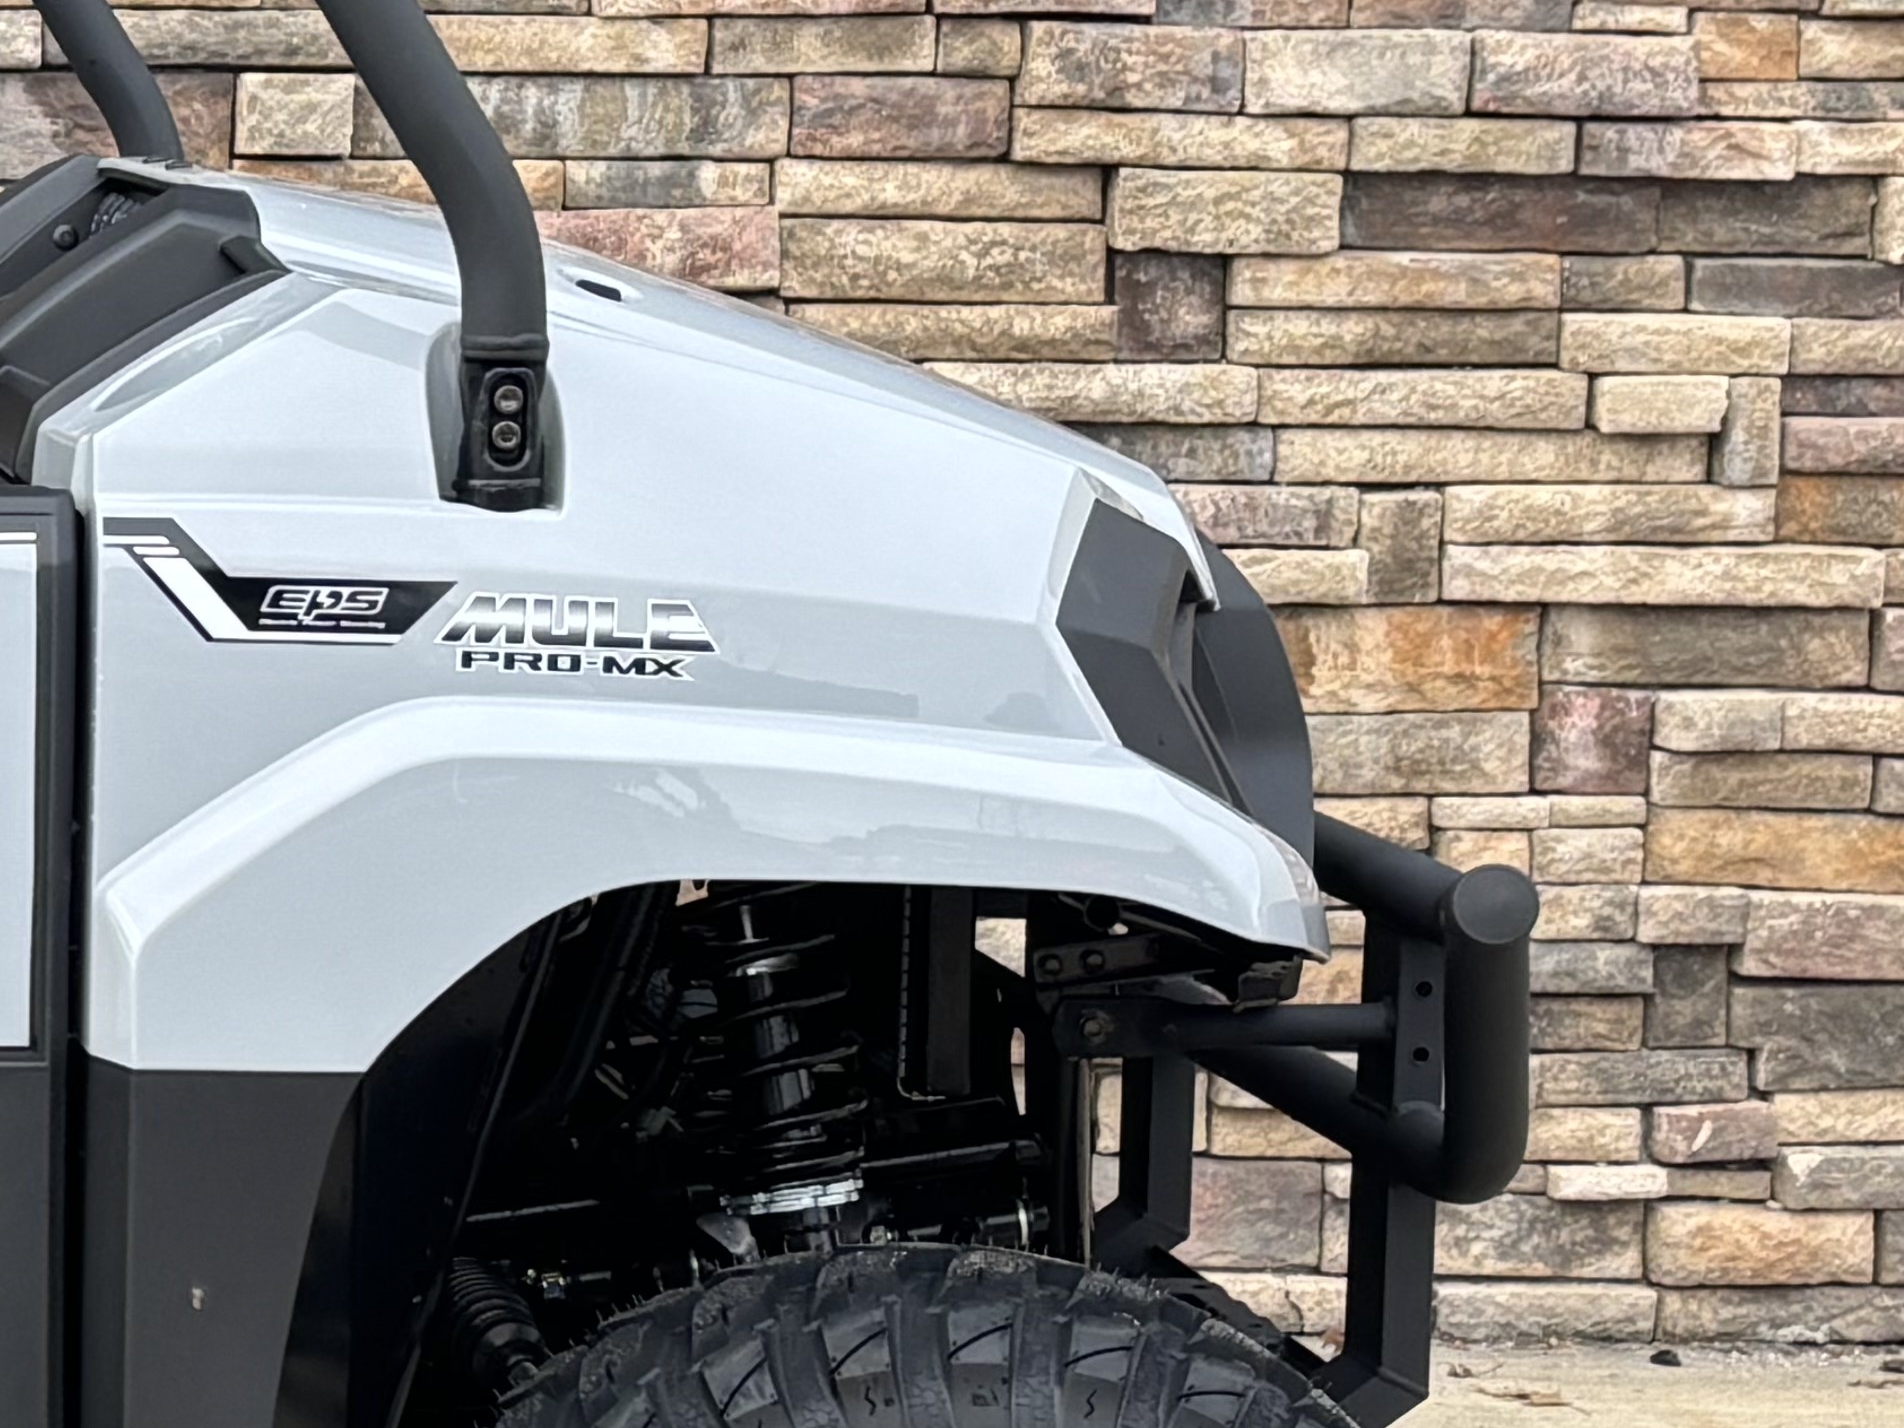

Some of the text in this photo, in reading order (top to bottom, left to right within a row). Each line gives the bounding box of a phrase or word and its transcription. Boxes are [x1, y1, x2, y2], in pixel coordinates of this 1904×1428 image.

[261, 585, 388, 620] EPS
[436, 593, 718, 653] MULE
[460, 650, 686, 678] PRO-MX
